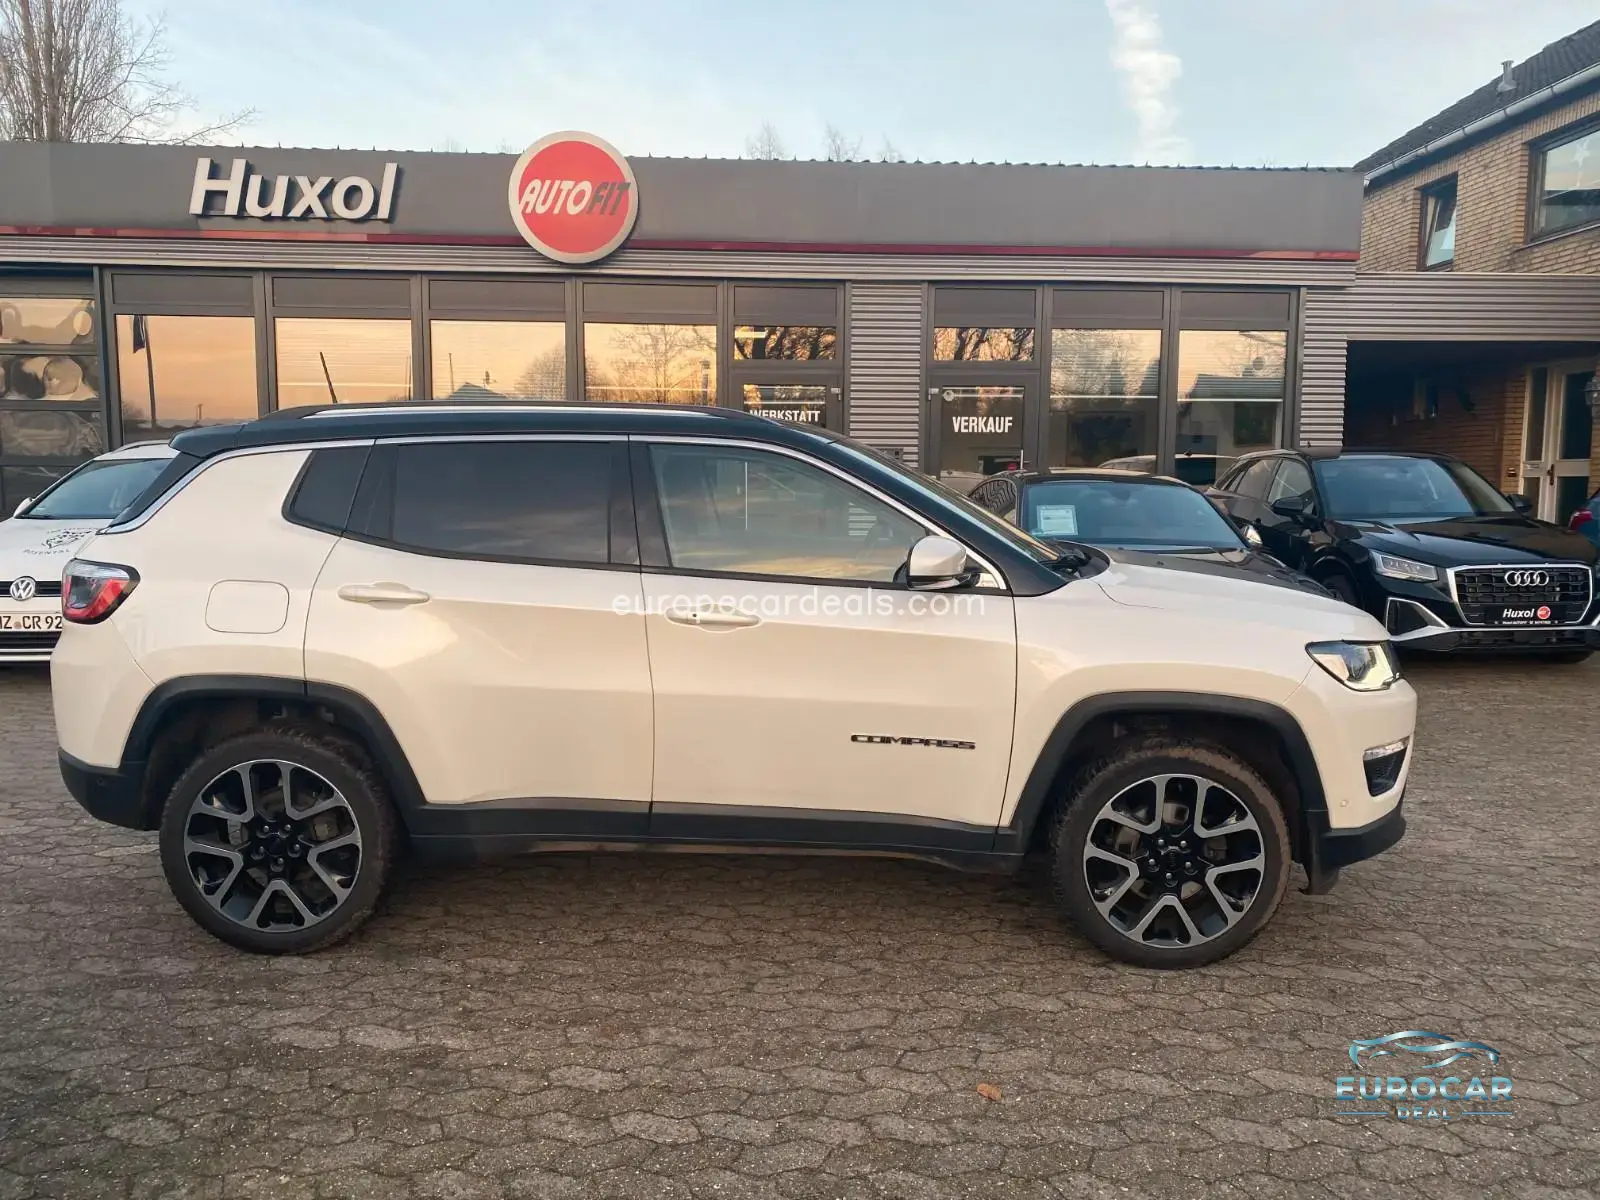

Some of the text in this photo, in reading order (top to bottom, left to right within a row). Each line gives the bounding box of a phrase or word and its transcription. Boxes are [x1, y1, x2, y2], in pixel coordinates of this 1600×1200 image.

[189, 157, 399, 219] Huxol
[520, 179, 631, 215] AUTOFIT
[952, 416, 1013, 433] VERKAUF
[1503, 608, 1535, 618] Huxol
[22, 616, 41, 629] CR
[851, 735, 976, 749] COMPASS
